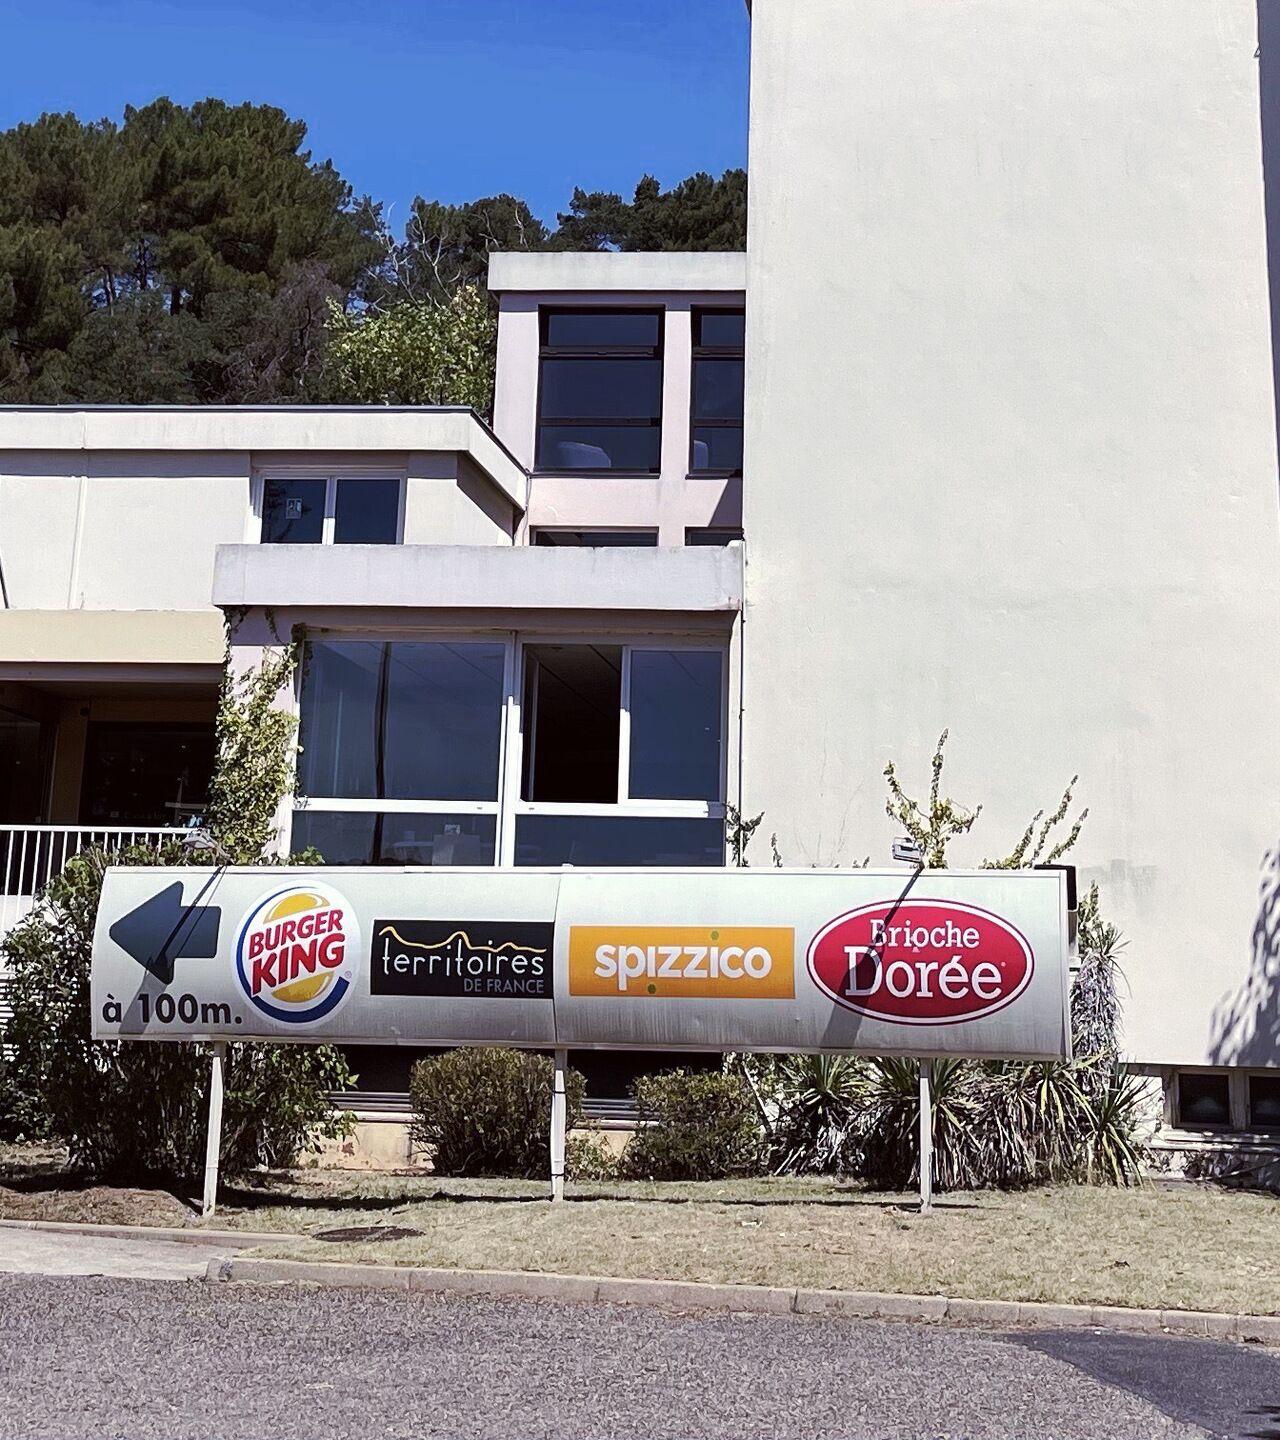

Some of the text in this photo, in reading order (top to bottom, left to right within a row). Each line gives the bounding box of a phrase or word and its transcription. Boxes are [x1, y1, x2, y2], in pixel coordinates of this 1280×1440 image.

[248, 909, 344, 959] BURGER
[870, 918, 980, 948] Brioche
[252, 933, 346, 996] KING
[382, 937, 544, 977] territoires
[594, 943, 773, 991] spizzico
[844, 945, 1002, 1000] Dorée
[464, 978, 544, 994] DE FRANCE
[102, 993, 242, 1024] à 100m.
